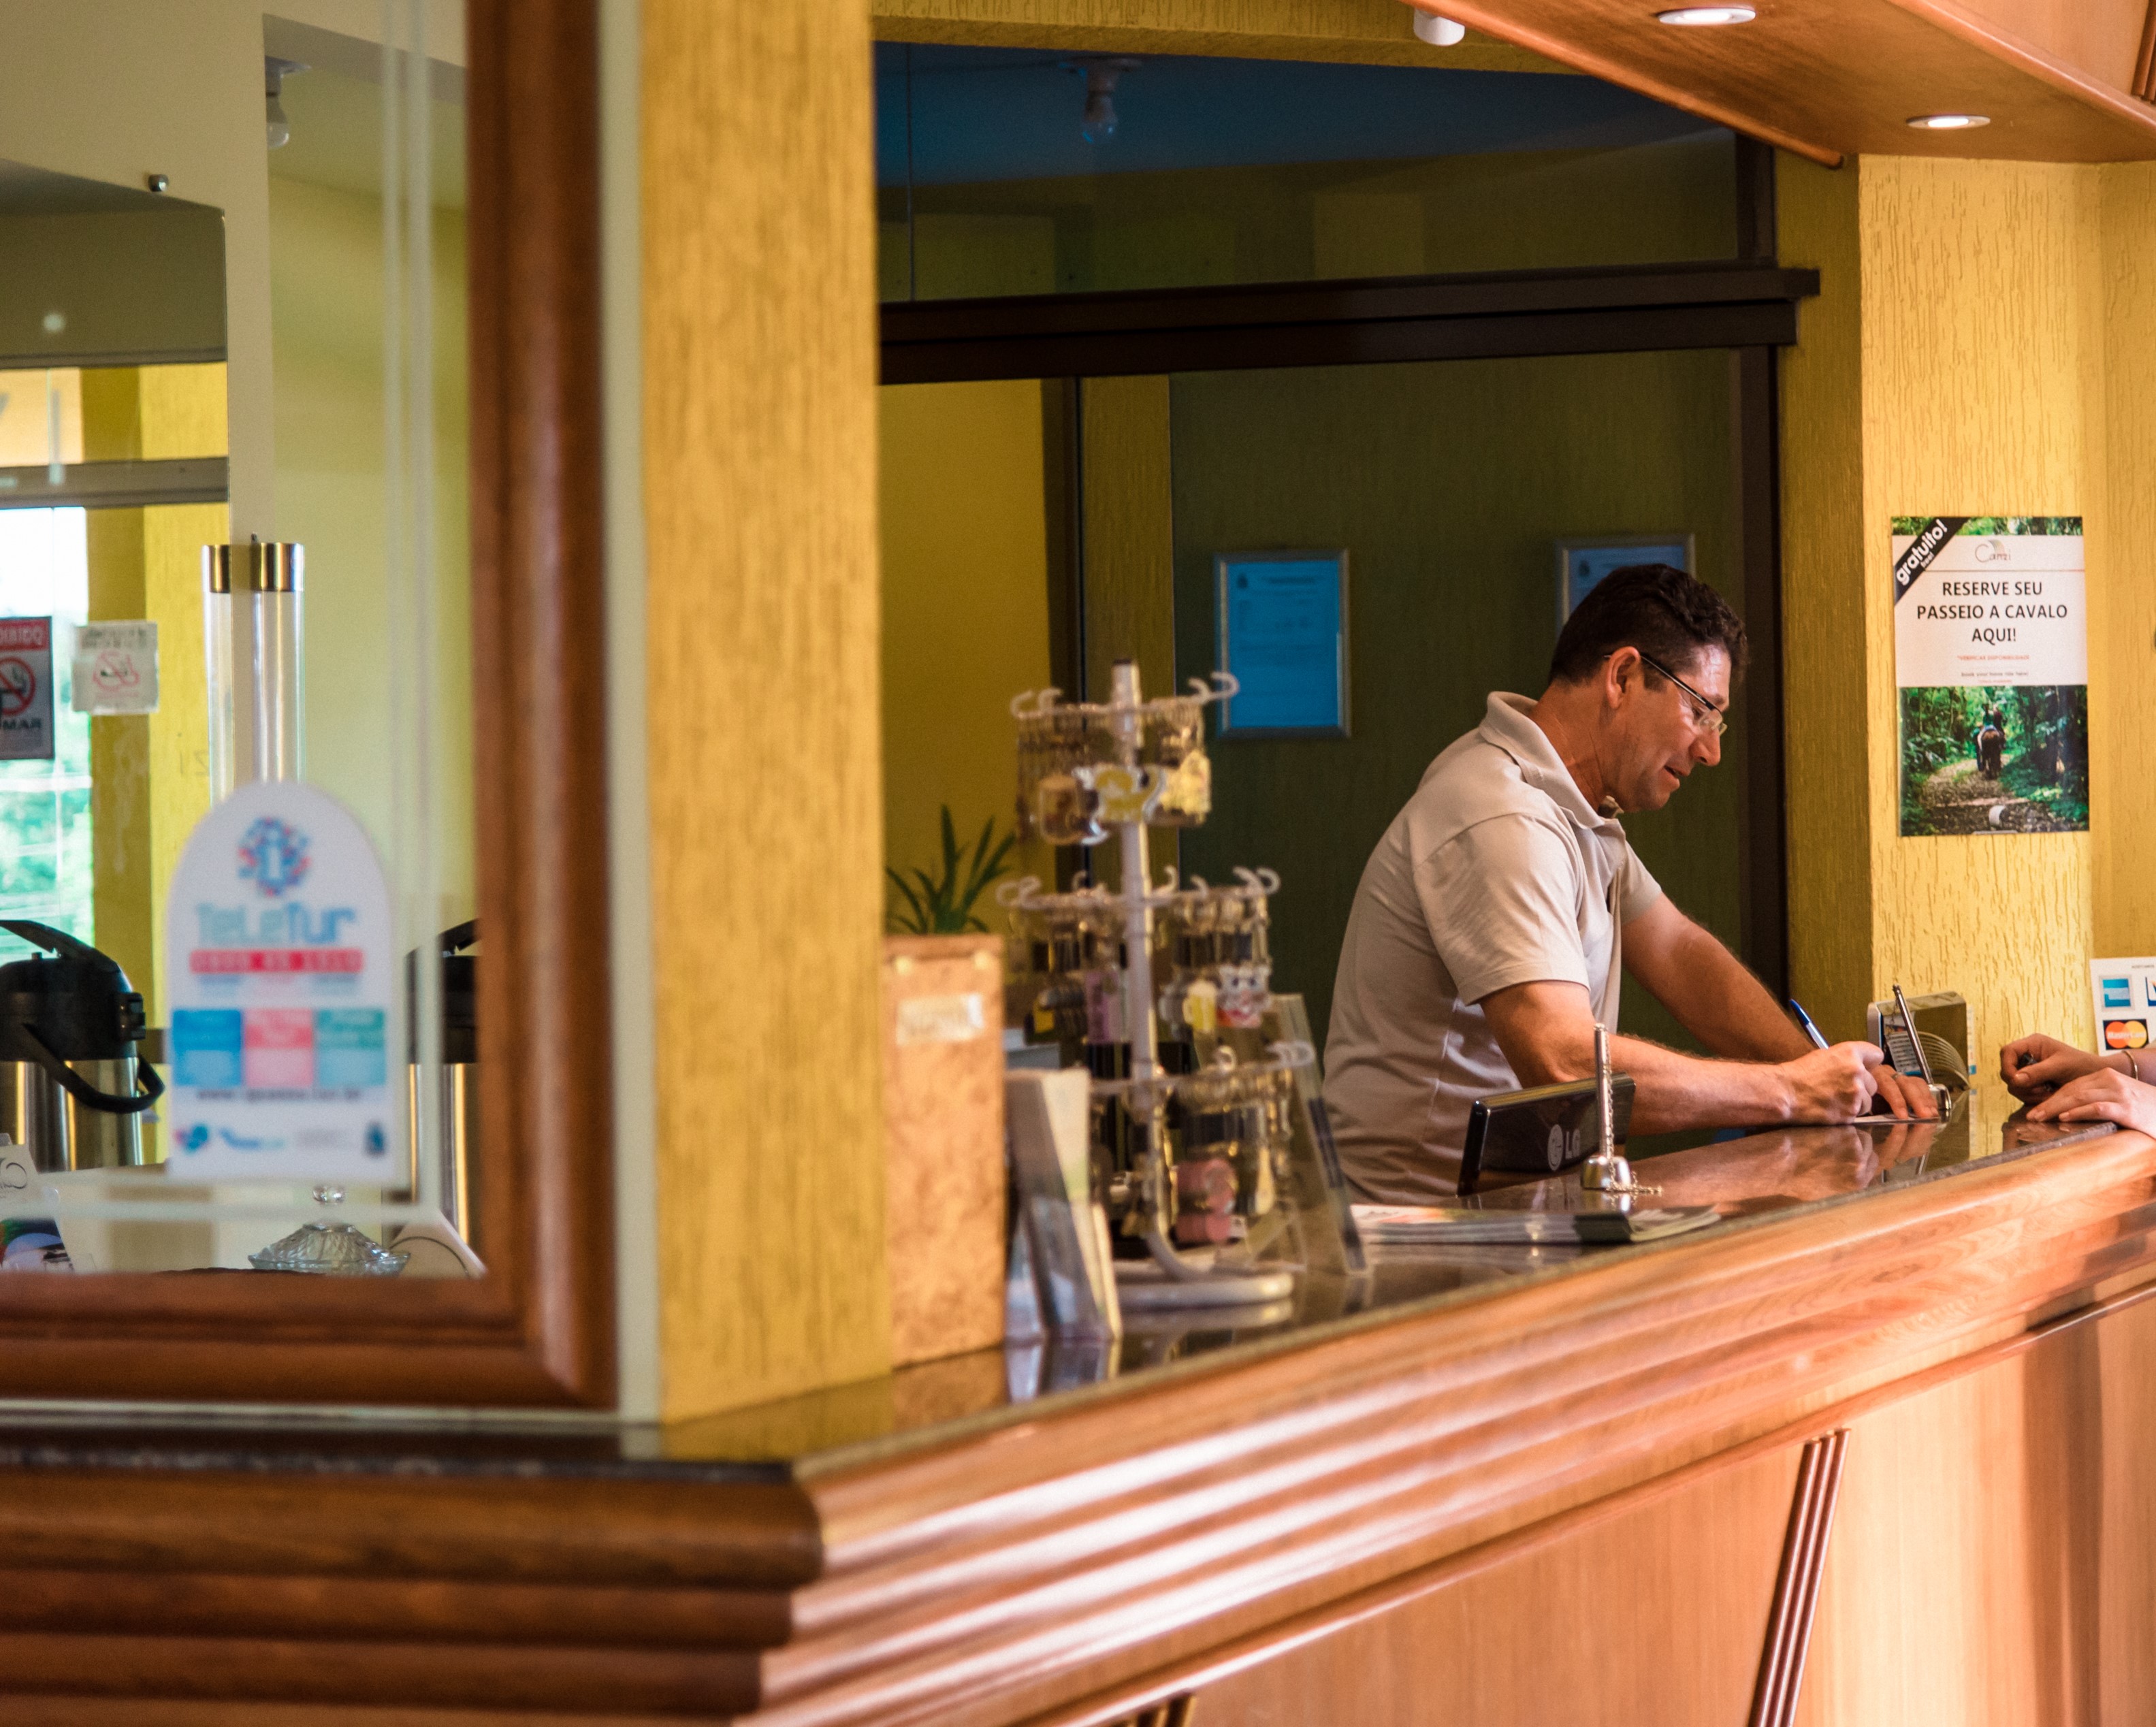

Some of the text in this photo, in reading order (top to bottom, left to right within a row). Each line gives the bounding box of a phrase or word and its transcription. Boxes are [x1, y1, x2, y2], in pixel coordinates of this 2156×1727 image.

[1896, 519, 1948, 586] gratuito!
[1942, 581, 2042, 596] RESERVE SEU
[1917, 604, 2067, 619] PASSEIO A CAVALO
[1972, 628, 2016, 645] AQUI!
[1565, 1128, 1581, 1160] LG
